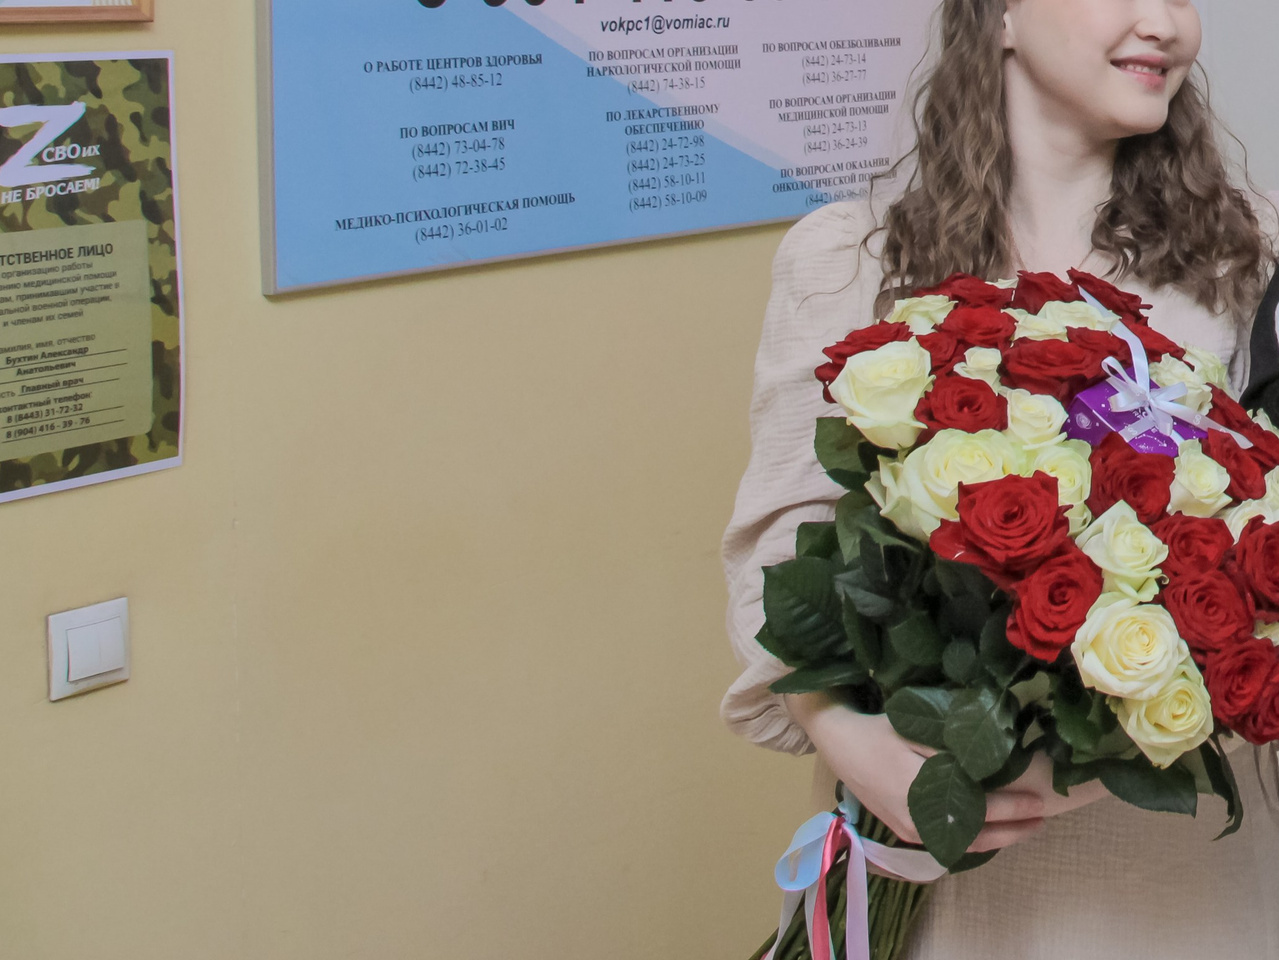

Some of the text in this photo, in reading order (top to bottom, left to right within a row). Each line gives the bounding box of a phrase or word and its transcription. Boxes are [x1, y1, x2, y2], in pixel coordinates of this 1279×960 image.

[600, 14, 730, 35] vokpc1@vomiac.ru
[589, 45, 738, 61] ПО ВОПРОСАМ ОРГАНИЗАЦИИ
[762, 37, 901, 53] ПО ВОПРОСАМ ОБЕЗБОЛИВАНИЯ
[364, 54, 542, 73] О РАБОТЕ ЦЕНТРОВ ЗДОРОВЬЯ
[587, 59, 741, 77] НАРКОЛОГИЧЕСКОЙ ПОМОЩИ
[802, 53, 866, 69] (8442) 24-73-14
[409, 73, 502, 94] (8442) 48-85-12
[627, 76, 705, 95] (8442) 74-38-15
[802, 69, 866, 86] (8442) 36-27-77
[769, 90, 896, 109] ПО ВОПРОСАМ ОРГАНИЗАЦИИ
[606, 104, 720, 121] ПО ЛЕКАРСТВЕННОМУ
[778, 104, 889, 122] МЕДИЦИНСКОЙ ПОМОЩИ
[400, 119, 515, 139] ПО ВОПРОСАМ ВИЧ
[624, 119, 705, 136] ОБЕСПЕЧЕНИЮ
[803, 121, 867, 138] (8442) 24-73-13
[412, 137, 505, 161] (8442) 73-04-78
[626, 135, 705, 155] (8442) 24-72-98
[804, 140, 830, 154] (8442)
[413, 157, 506, 182] (8442) 72-38-45
[627, 153, 705, 175] (8442) 24-73-25
[780, 157, 890, 178] ПО ВОПРОСАМ ОКАЗАНИЯ
[1, 178, 100, 204] НЕ БРОСАЕМ!
[628, 172, 705, 194] (8442) 58-10-11
[772, 173, 856, 193] ОНКОЛОГИЧЕСКОЙ
[629, 190, 707, 213] (8442) 58-10-09
[805, 193, 832, 207] (8442)
[335, 193, 575, 231] МЕДИКО-ПСИХОЛОГИЧЕСКАЯ ПОМОЩЬ
[415, 218, 507, 244] (8442) 36-01-02
[0, 243, 113, 266] ТСТВЕННОЕ ЛИЦО
[1, 262, 93, 279] организацию работы
[23, 271, 117, 288] медицинской помощи
[32, 299, 68, 311] военной
[6, 347, 89, 366] Бухтин Александр
[16, 361, 76, 376] Анатольевич
[22, 378, 84, 393] Главный врач
[46, 404, 83, 416] 31-72-32
